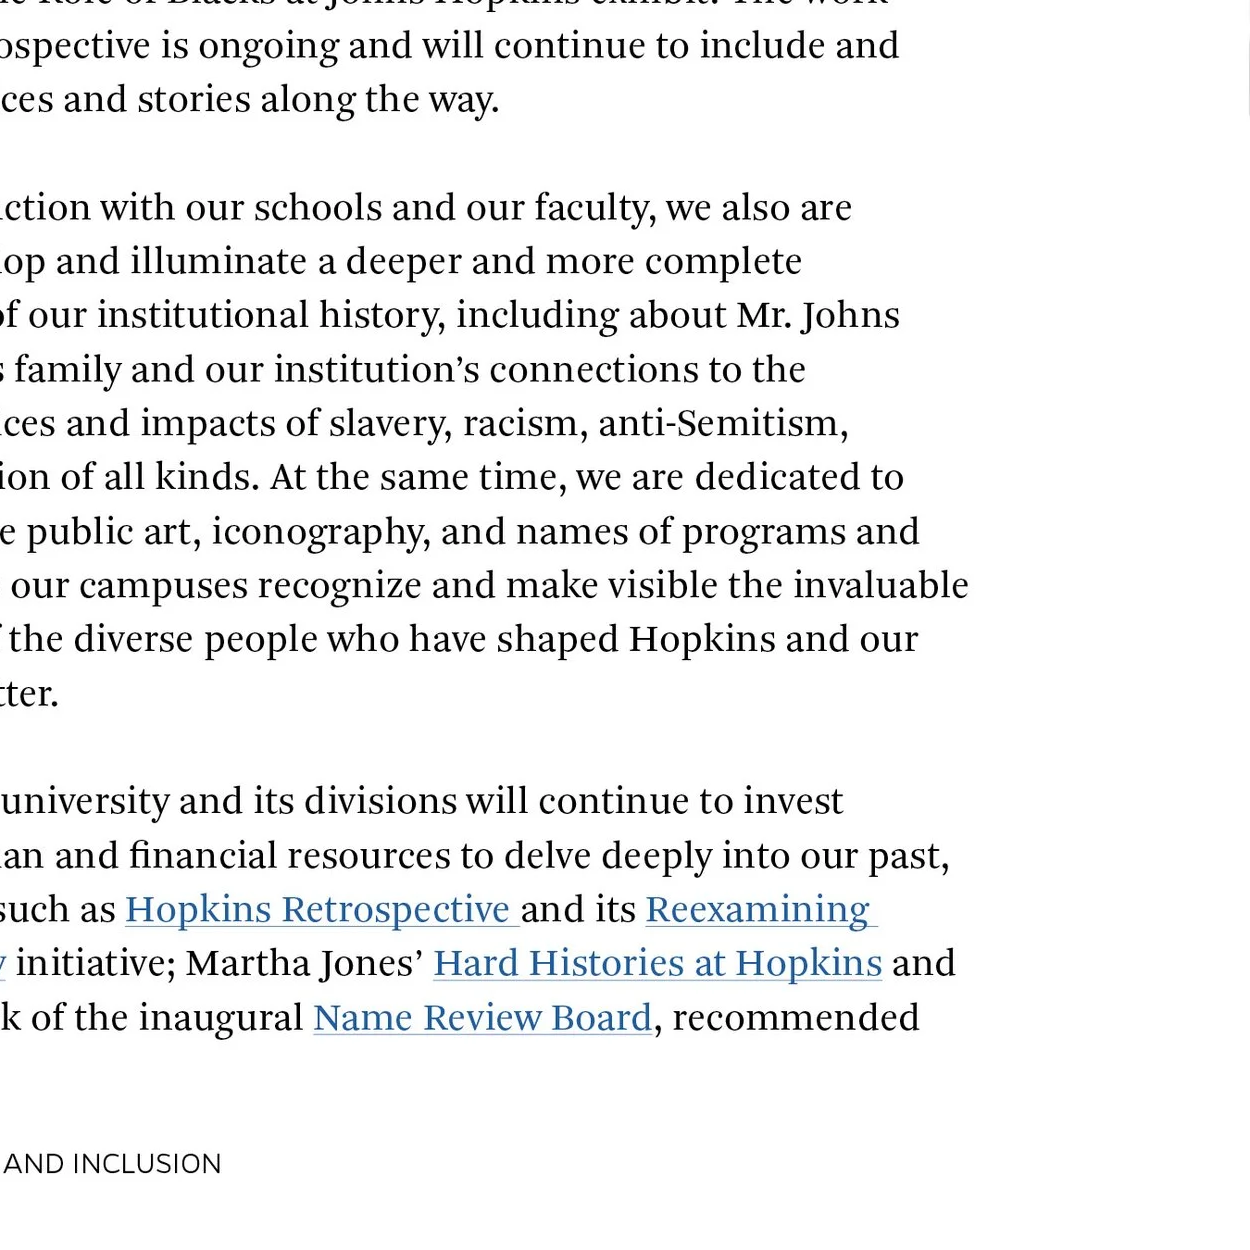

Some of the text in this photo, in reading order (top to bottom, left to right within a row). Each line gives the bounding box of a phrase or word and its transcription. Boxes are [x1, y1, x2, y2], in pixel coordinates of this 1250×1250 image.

[28, 307, 88, 329] our
[97, 298, 310, 329] institutional
[319, 298, 445, 338] history,
[456, 298, 621, 338] including
[629, 298, 728, 329] about
[736, 302, 792, 329] Mr.
[799, 298, 900, 336] Johns
[80, 902, 116, 923] as
[124, 892, 271, 932] Hopkins
[282, 892, 510, 932] Retrospective
[521, 893, 585, 923] and
[595, 892, 636, 923] its
[645, 892, 871, 933] Reexamining
[15, 946, 175, 984] initiative;
[185, 947, 312, 977] Martha
[317, 949, 422, 984] Jones’
[433, 947, 520, 982] Hard
[529, 946, 684, 982] Histories
[695, 950, 727, 977] at
[735, 946, 883, 985] Hopkins
[892, 947, 957, 977] and
[31, 1001, 68, 1032] of
[74, 1001, 128, 1032] the
[139, 1001, 304, 1041] inaugural
[313, 1004, 412, 1036] Name
[423, 1001, 544, 1032] Review
[551, 1001, 662, 1039] Board,
[672, 1001, 921, 1032] recommended
[2, 1152, 64, 1174] AND
[74, 1152, 221, 1174] INCLUSION
